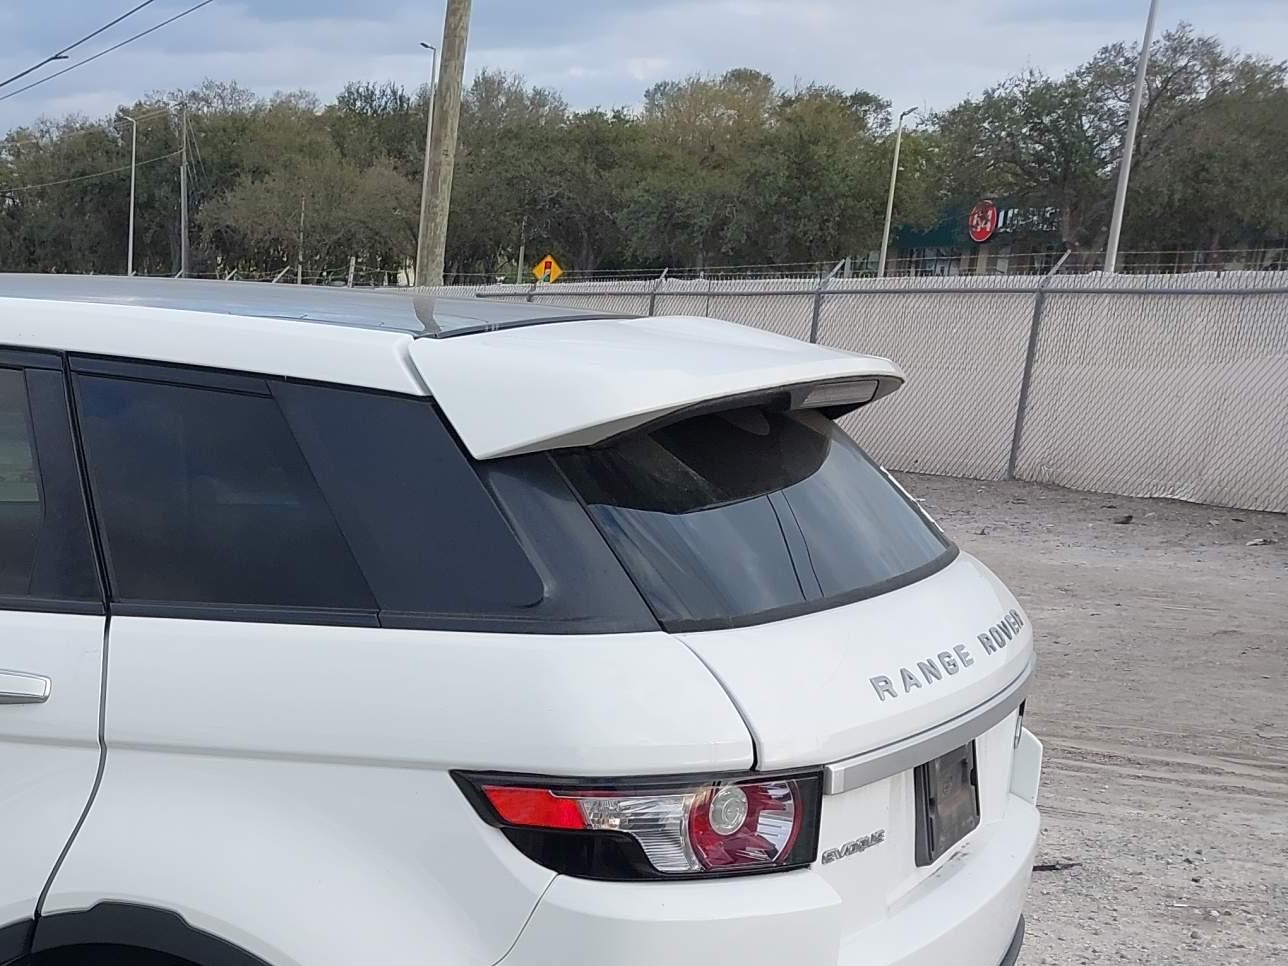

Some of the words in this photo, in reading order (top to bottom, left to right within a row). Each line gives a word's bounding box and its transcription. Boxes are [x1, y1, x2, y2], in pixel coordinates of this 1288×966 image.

[869, 644, 975, 701] RANGE
[977, 608, 1024, 656] ROVER
[821, 828, 886, 865] EVOQUE
